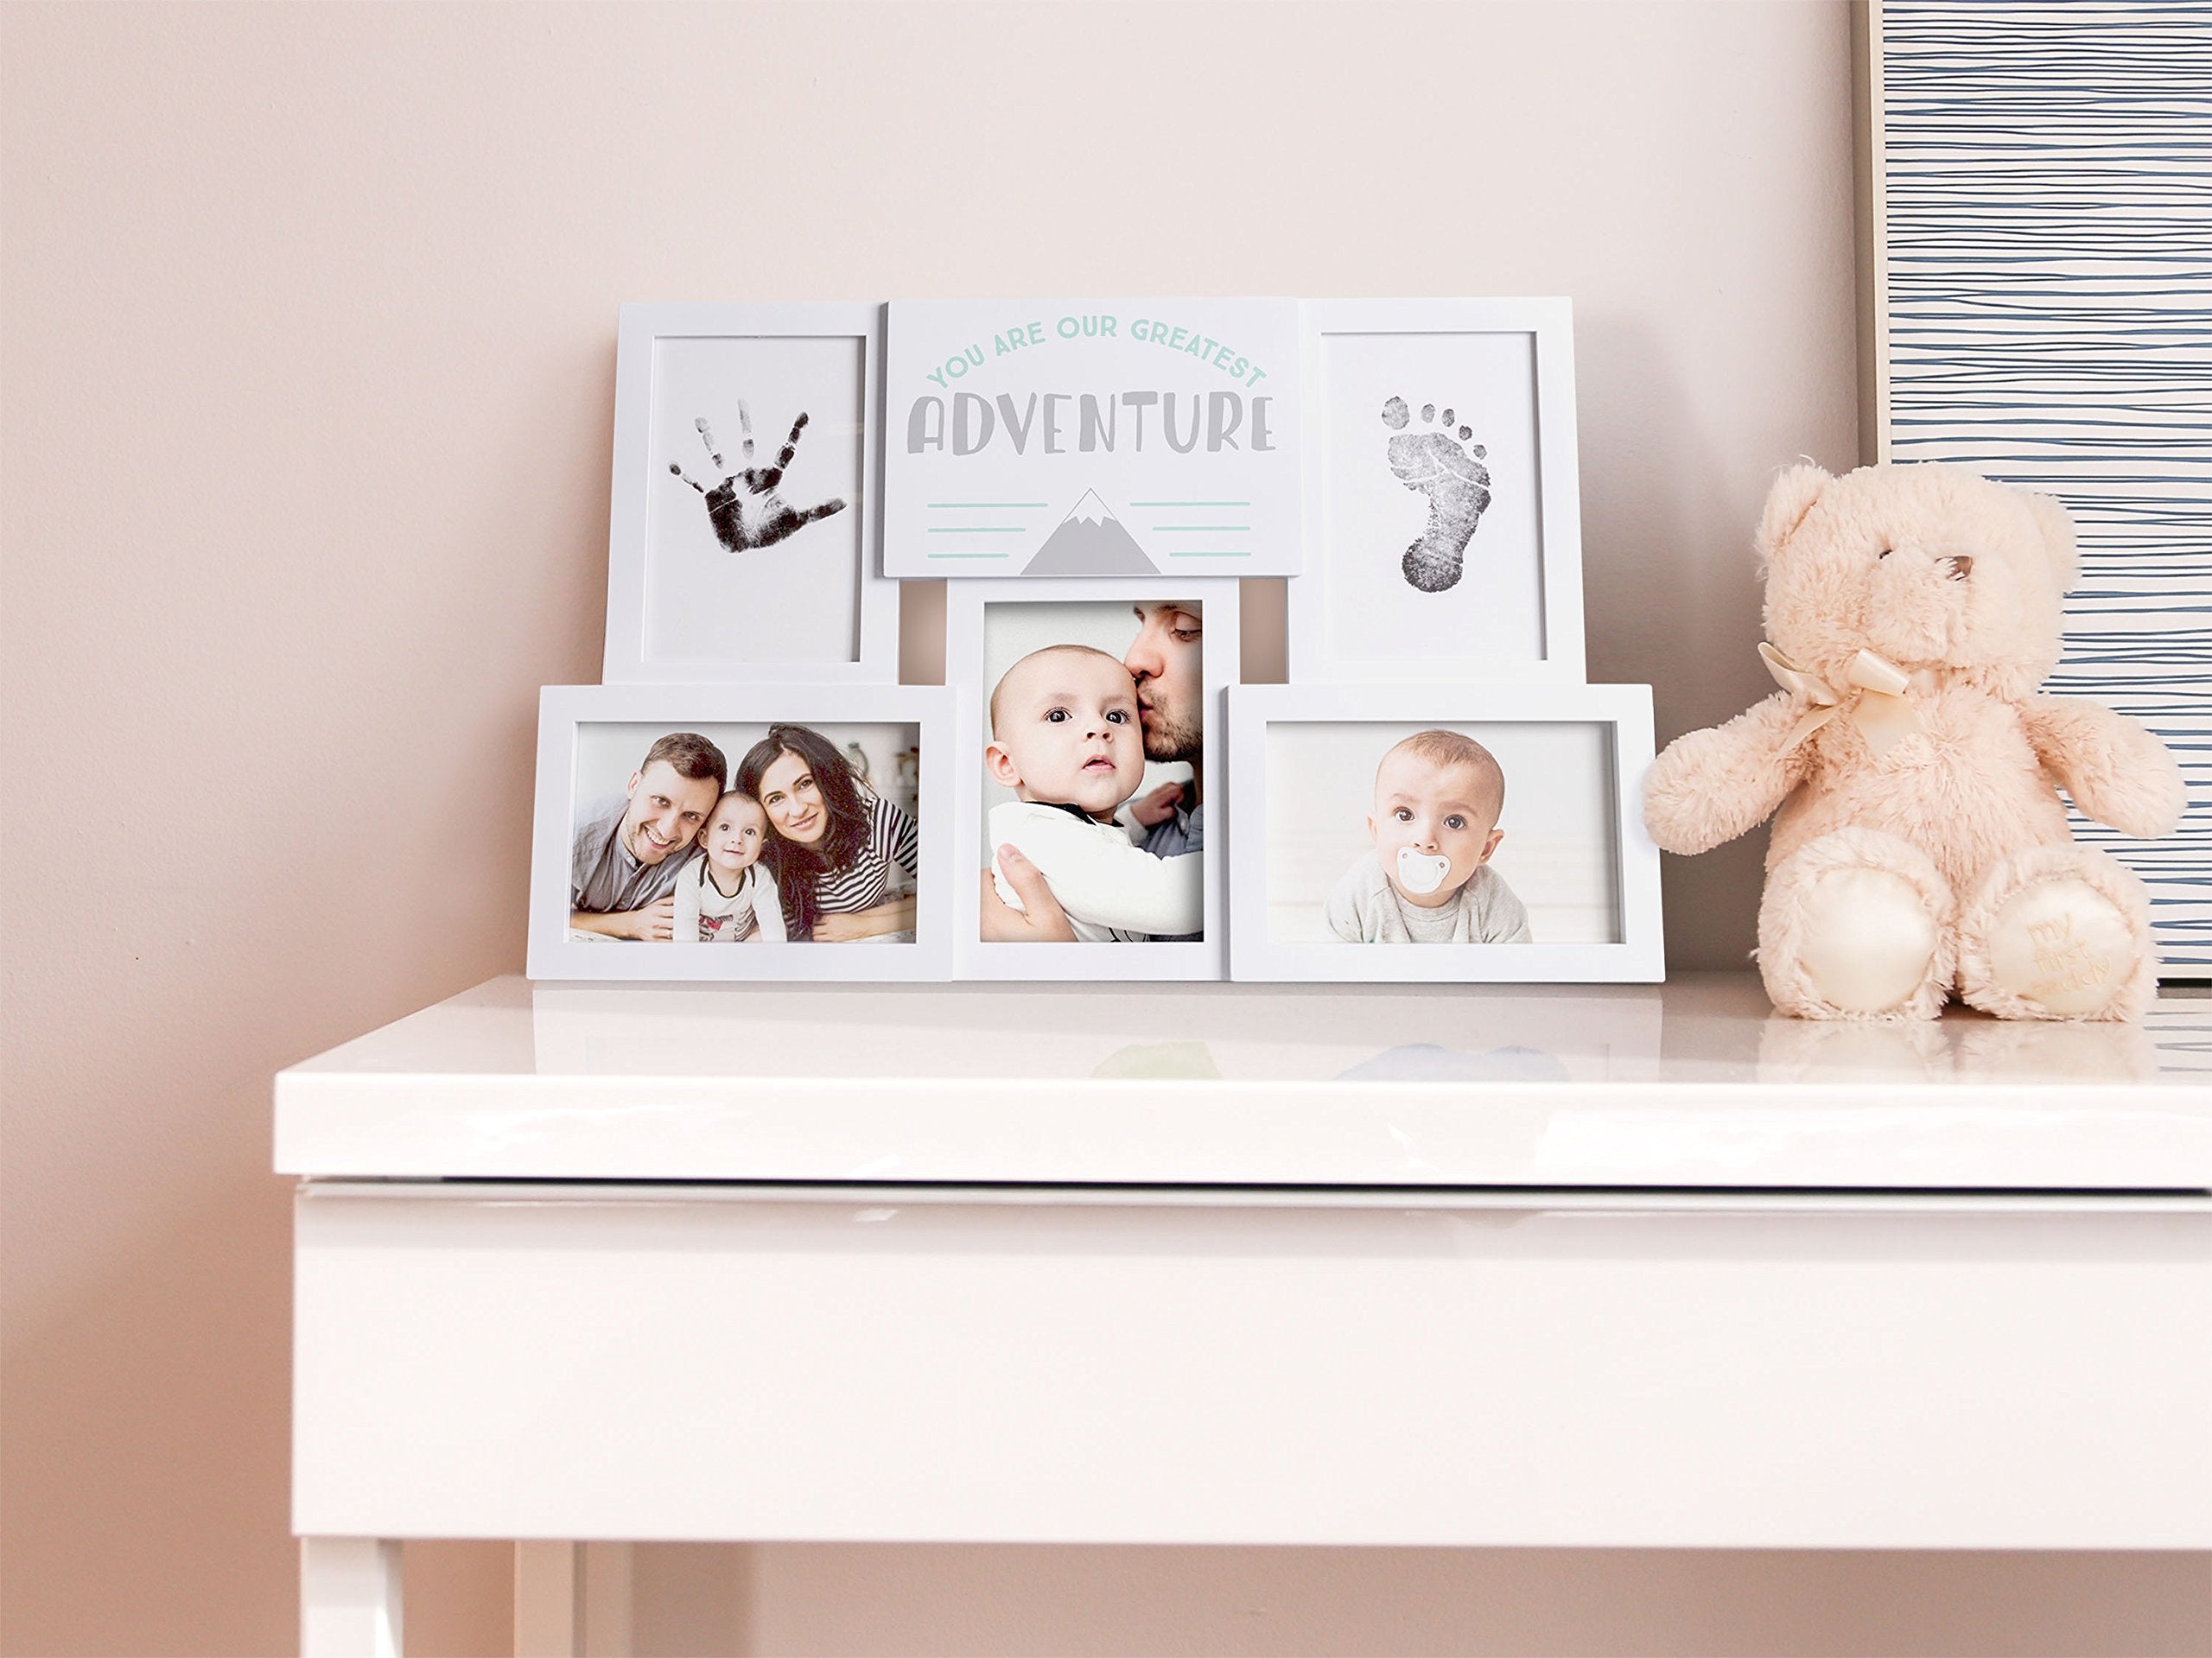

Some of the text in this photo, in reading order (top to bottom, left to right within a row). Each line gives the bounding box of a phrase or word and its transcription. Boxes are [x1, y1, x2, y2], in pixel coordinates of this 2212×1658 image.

[926, 314, 1268, 388] YOU ARE OUR GREATEST
[906, 391, 1277, 456] ADVENTURE
[2025, 912, 2071, 945] my
